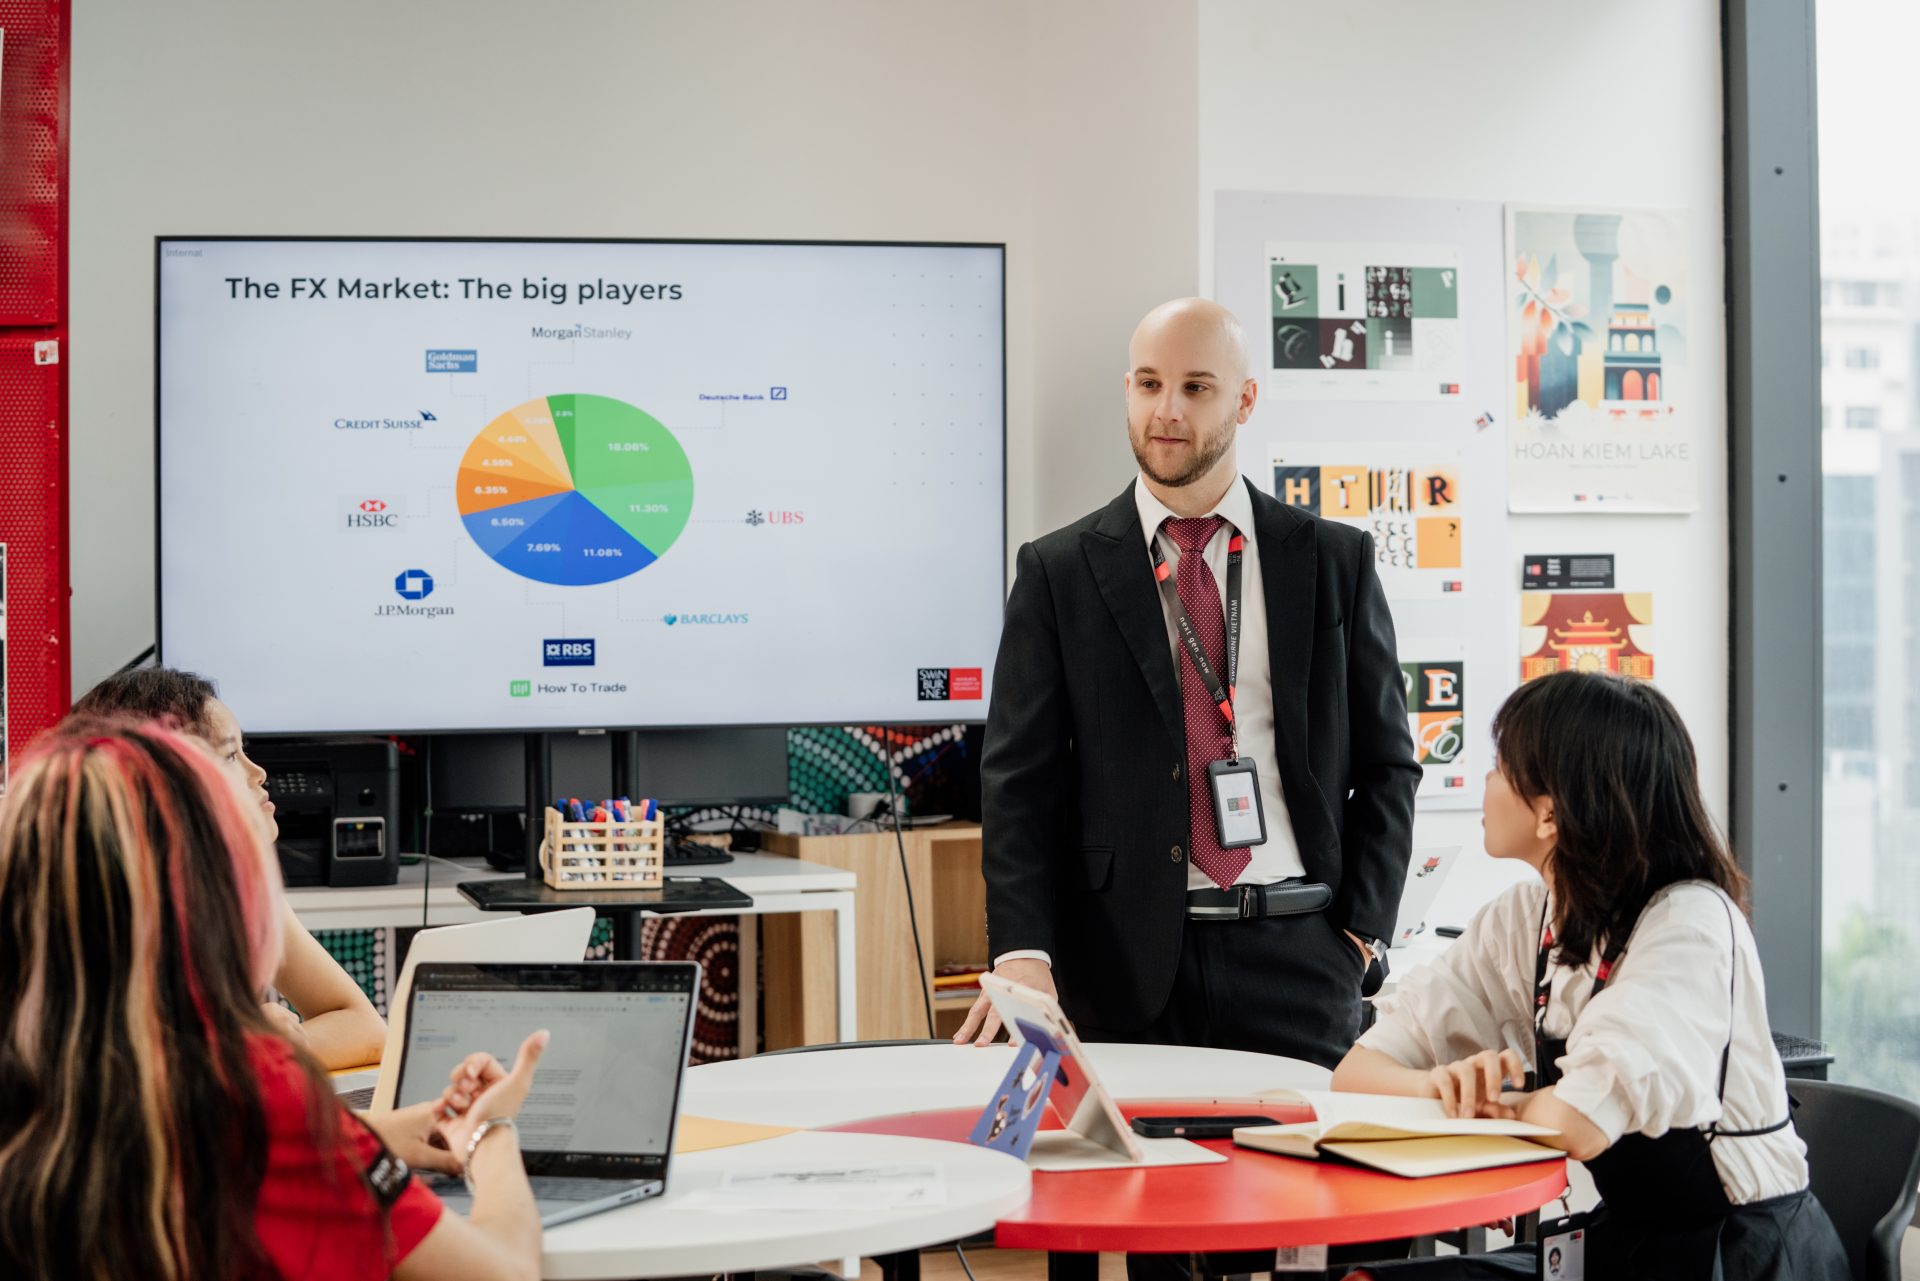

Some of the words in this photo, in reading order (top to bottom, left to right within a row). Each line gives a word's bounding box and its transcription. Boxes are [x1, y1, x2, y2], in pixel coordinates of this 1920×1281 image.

[165, 248, 203, 258] Internal
[226, 277, 280, 299] The
[291, 277, 327, 299] FX
[338, 277, 450, 300] Market:
[459, 278, 513, 300] The
[523, 277, 568, 305] big
[578, 278, 683, 305] players
[428, 352, 475, 362] Goldman
[428, 361, 461, 370] Sachs
[699, 393, 740, 401] Deutsche
[742, 393, 764, 401] Bank
[334, 417, 381, 430] CREDIT
[382, 417, 424, 430] SUISSE
[1514, 442, 1577, 460] HOAN
[1581, 442, 1633, 460] KIEM
[1639, 442, 1690, 461] LAKE
[347, 513, 399, 528] HSBC
[491, 518, 526, 527] 6.50%
[768, 510, 804, 525] UBS
[527, 543, 562, 553] 7.69%
[583, 548, 623, 558] 11.08%
[680, 613, 749, 625] BARCLAYS
[1230, 599, 1238, 634] VIETNAM
[1179, 616, 1192, 636] next
[561, 643, 593, 657] RBS
[538, 682, 568, 694] How
[570, 682, 588, 694] To
[589, 681, 628, 694] Trade
